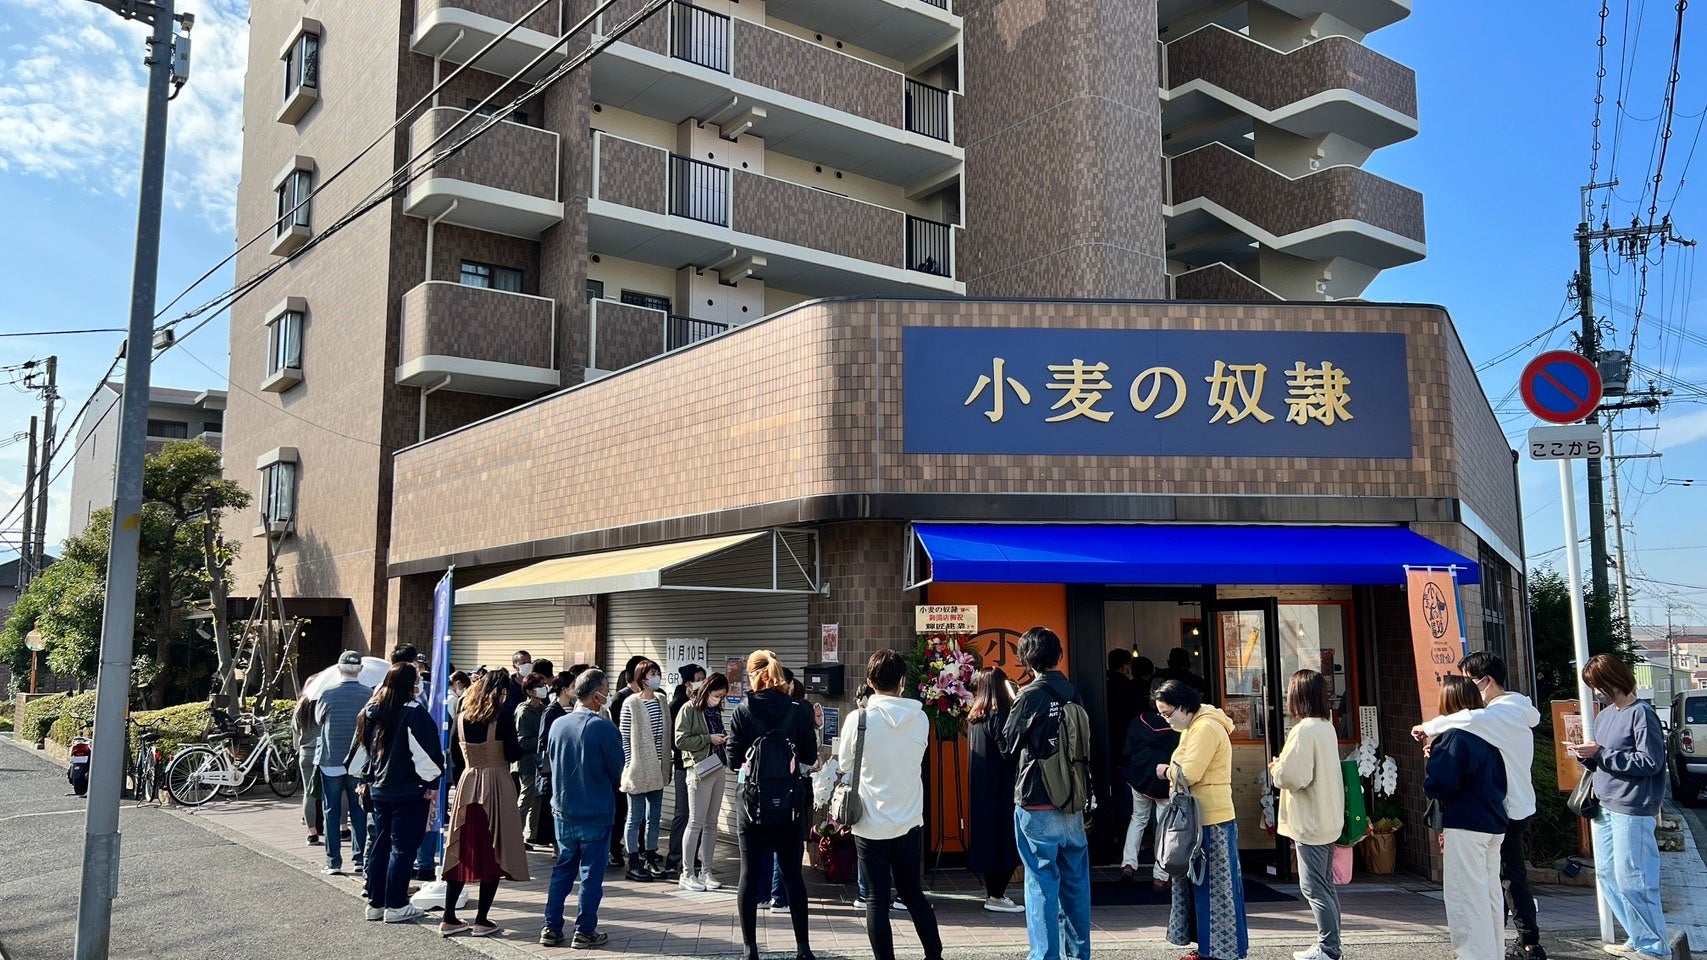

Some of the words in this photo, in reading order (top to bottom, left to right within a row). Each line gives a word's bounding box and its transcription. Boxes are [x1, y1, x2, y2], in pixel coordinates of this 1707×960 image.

[964, 357, 1354, 426] 小麦の奴隷
[1532, 441, 1601, 457] ここから
[919, 605, 959, 614] 小麦の奴隷
[667, 645, 705, 661] 11月10日
